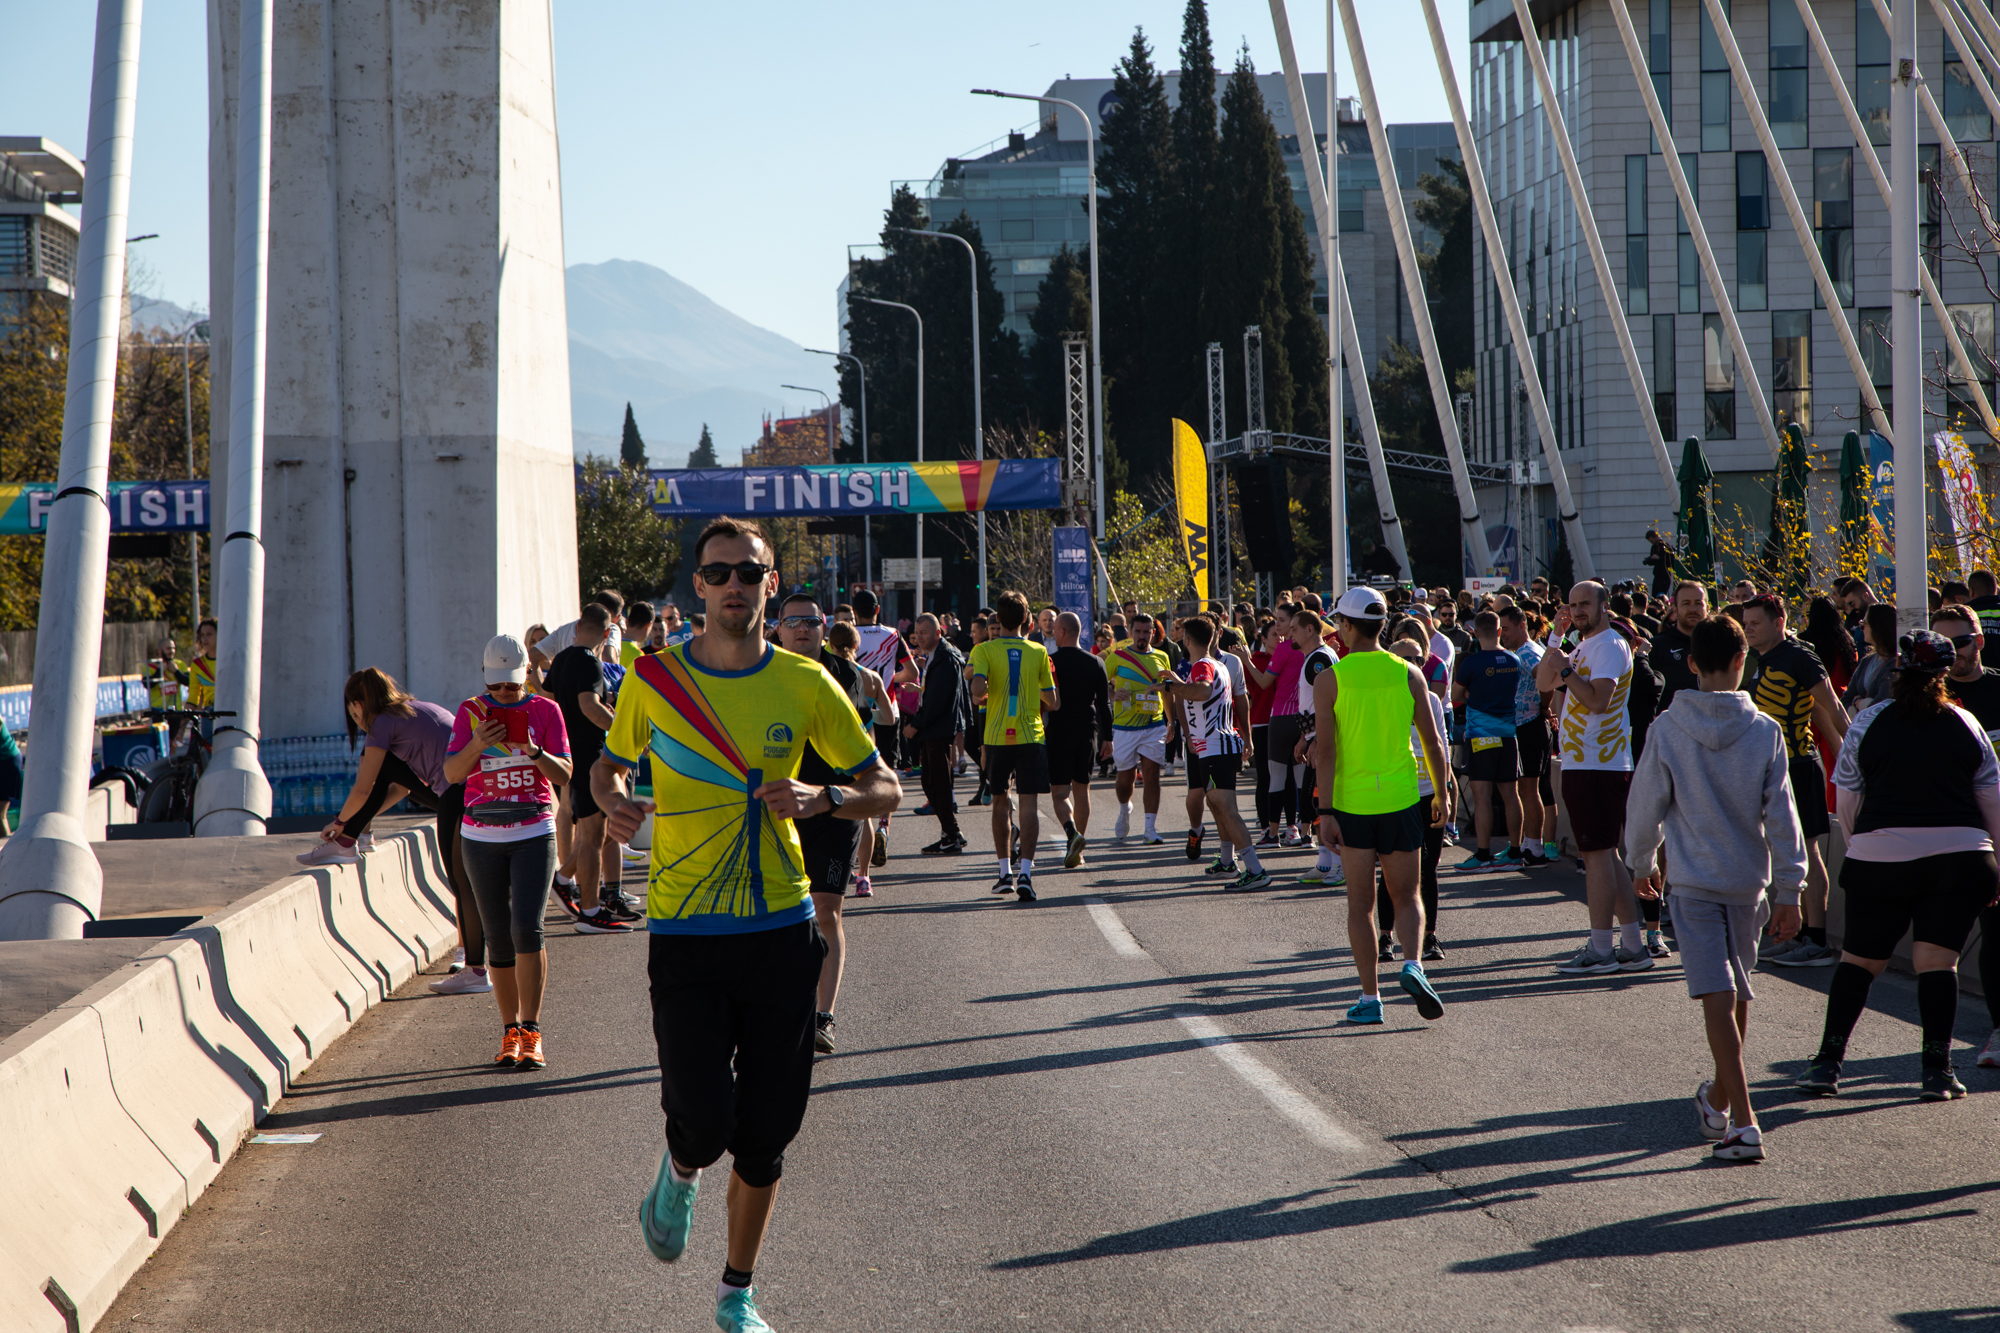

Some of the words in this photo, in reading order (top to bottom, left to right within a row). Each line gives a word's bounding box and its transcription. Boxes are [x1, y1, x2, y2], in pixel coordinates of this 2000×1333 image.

[744, 471, 909, 510] FINISH
[29, 489, 205, 529] FISH
[1060, 582, 1086, 590] Hilton
[1142, 701, 1158, 712] 283
[496, 769, 535, 790] 555
